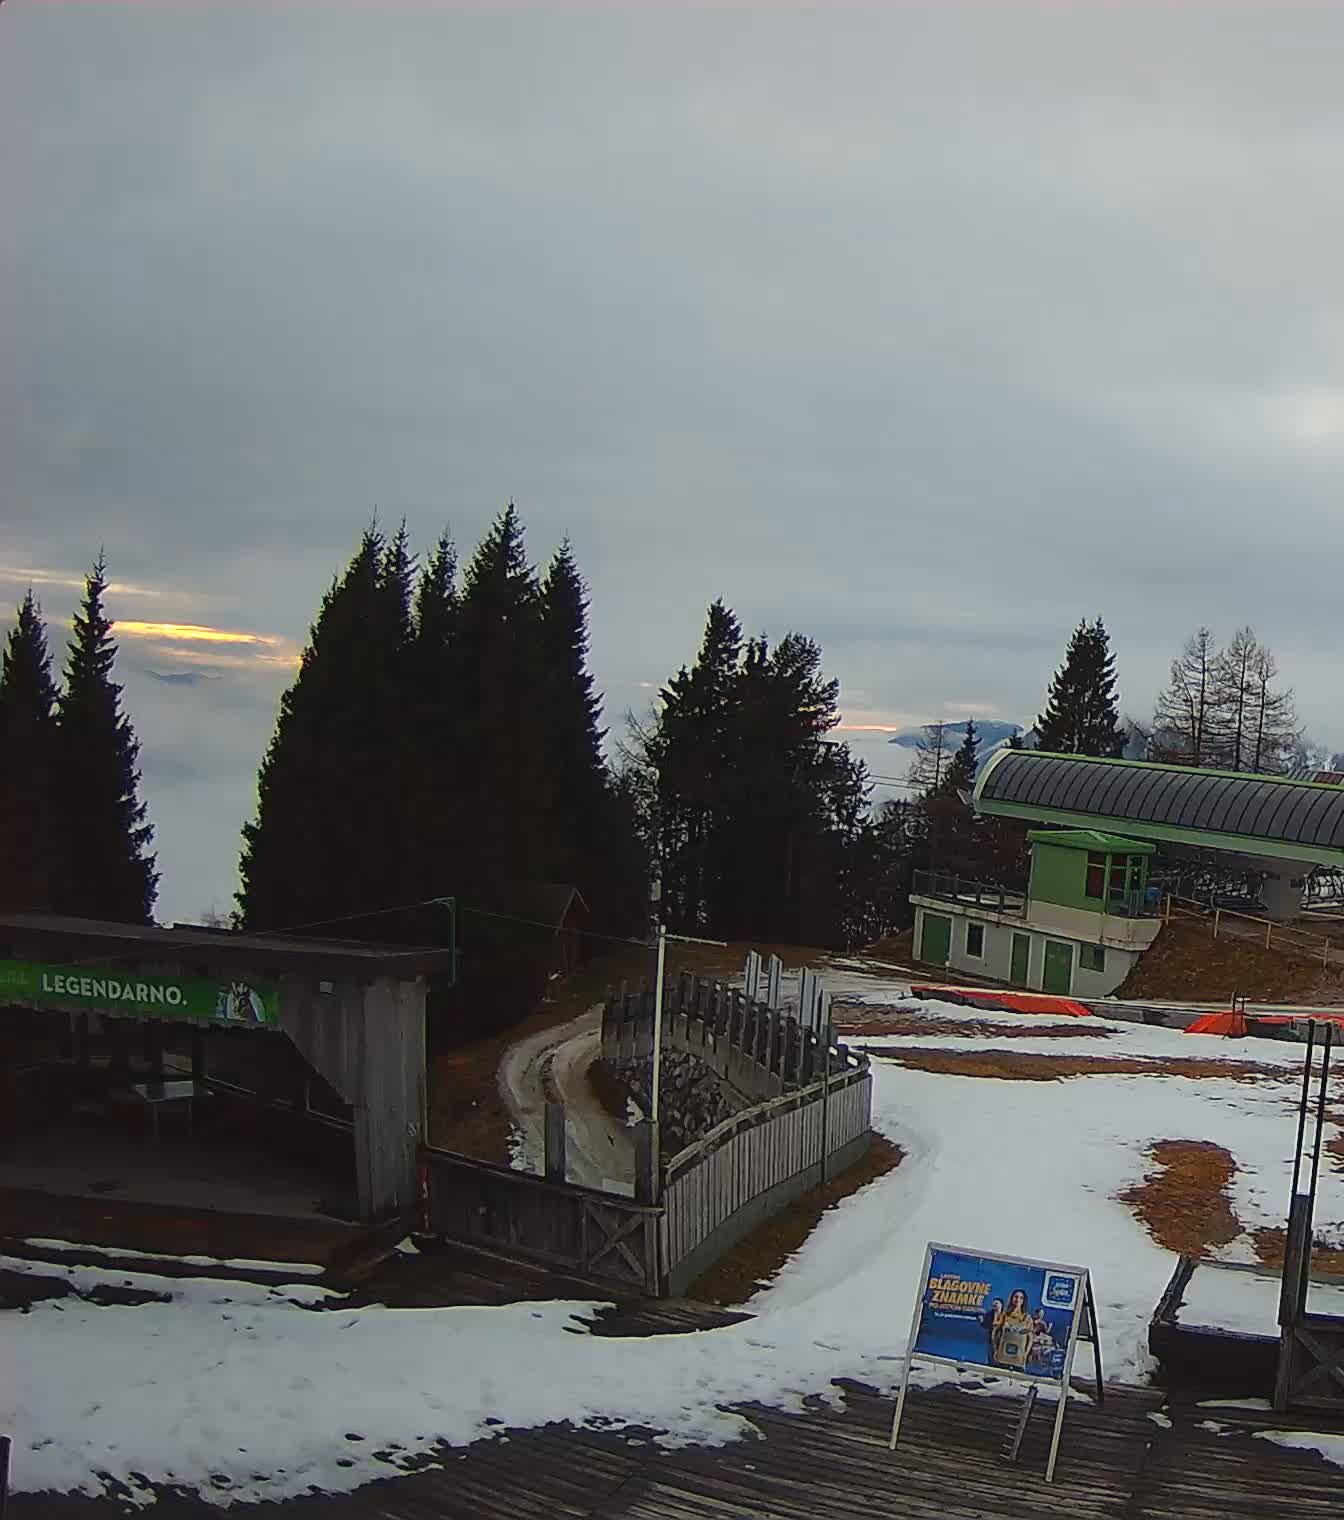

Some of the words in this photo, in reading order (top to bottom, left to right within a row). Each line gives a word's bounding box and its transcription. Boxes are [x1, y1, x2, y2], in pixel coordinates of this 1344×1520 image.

[42, 973, 188, 1006] LEGENDARNO.
[928, 1278, 992, 1296] BLAGOVNE
[931, 1290, 985, 1306] ZNAMKE
